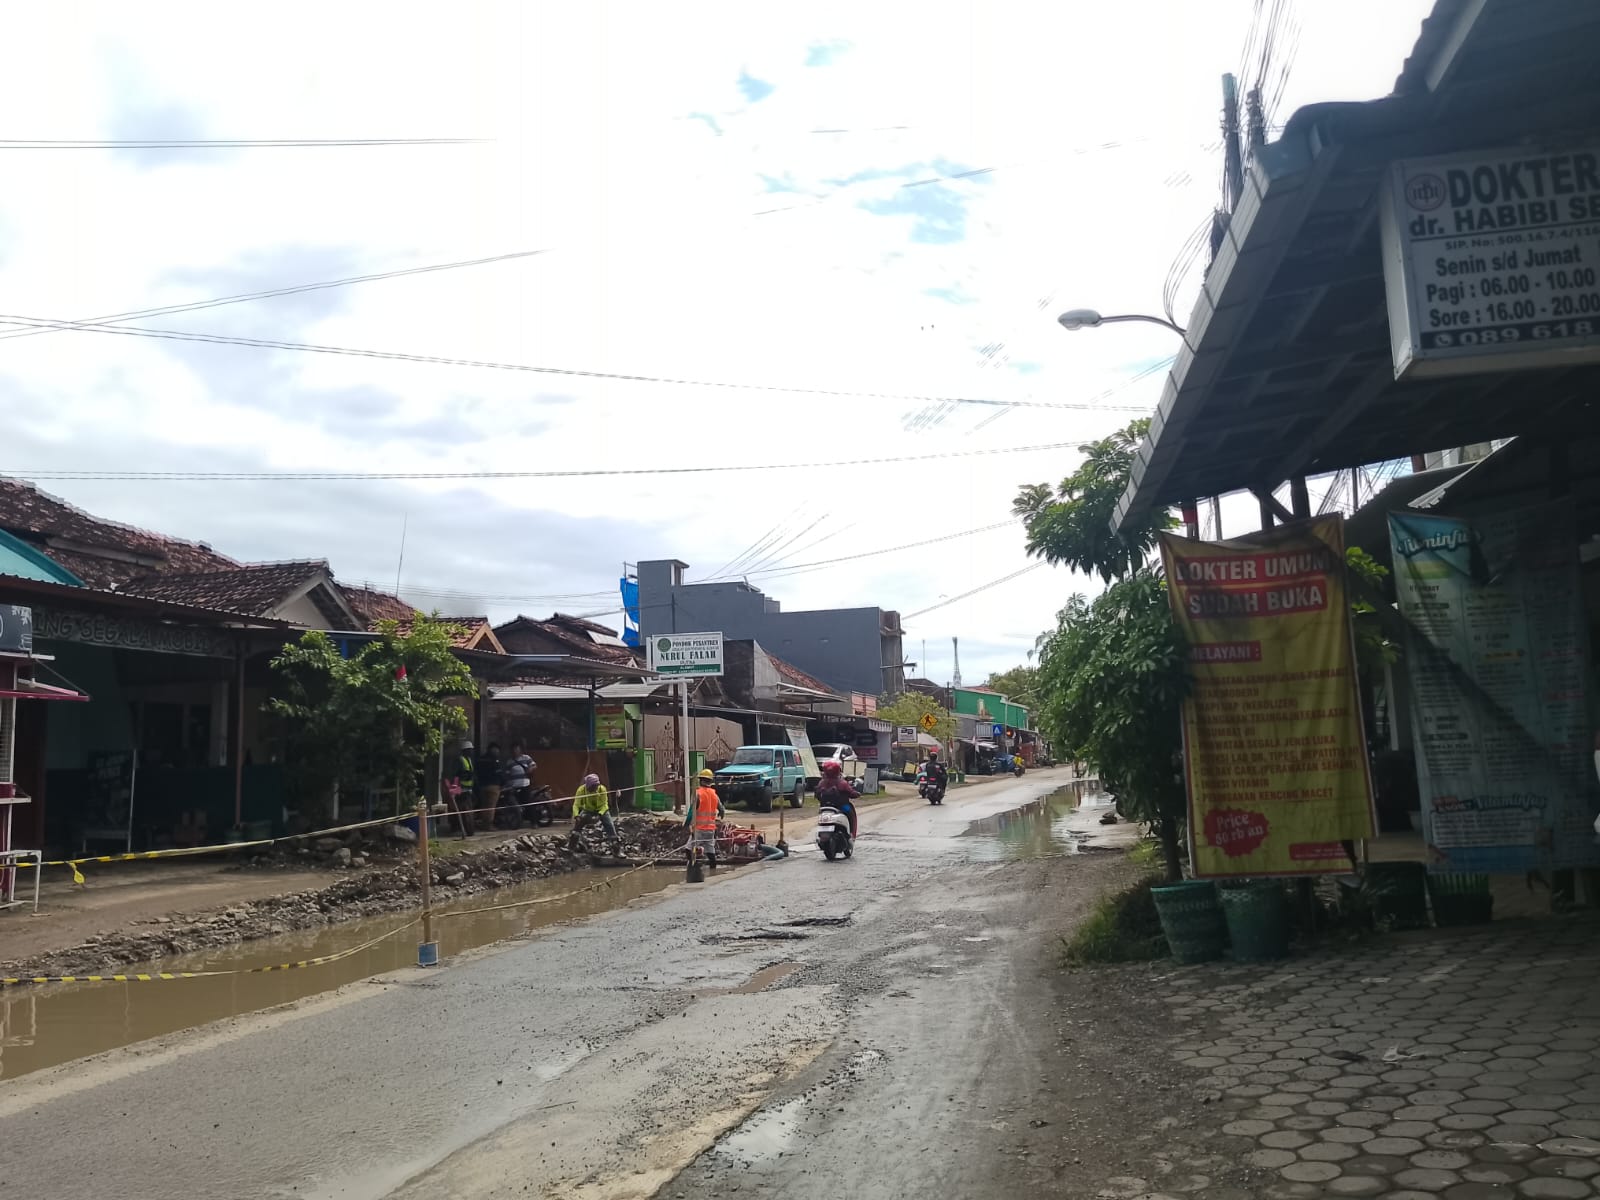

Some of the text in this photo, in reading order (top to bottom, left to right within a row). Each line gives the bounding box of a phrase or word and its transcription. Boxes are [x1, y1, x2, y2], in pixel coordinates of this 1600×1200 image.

[1447, 153, 1600, 208] DOKTER
[1410, 213, 1445, 236] dr.
[1454, 199, 1559, 232] HABIBI
[1435, 243, 1582, 277] Senin s/d Jumat
[1425, 283, 1465, 305] Pagi
[1480, 274, 1530, 297] 06.00
[1546, 267, 1596, 290] 10.00
[1429, 308, 1470, 327] Sore
[1486, 299, 1535, 322] 16.00
[1552, 293, 1600, 316] 20.00
[1458, 319, 1594, 345] 089 618
[1266, 585, 1323, 611] BUKA
[80, 616, 152, 646] SEGALA
[690, 650, 716, 660] FALAH
[1199, 740, 1244, 750] WATAN
[1231, 777, 1269, 789] VITAMIN
[1301, 787, 1334, 799] MACET
[1216, 813, 1249, 832] Price
